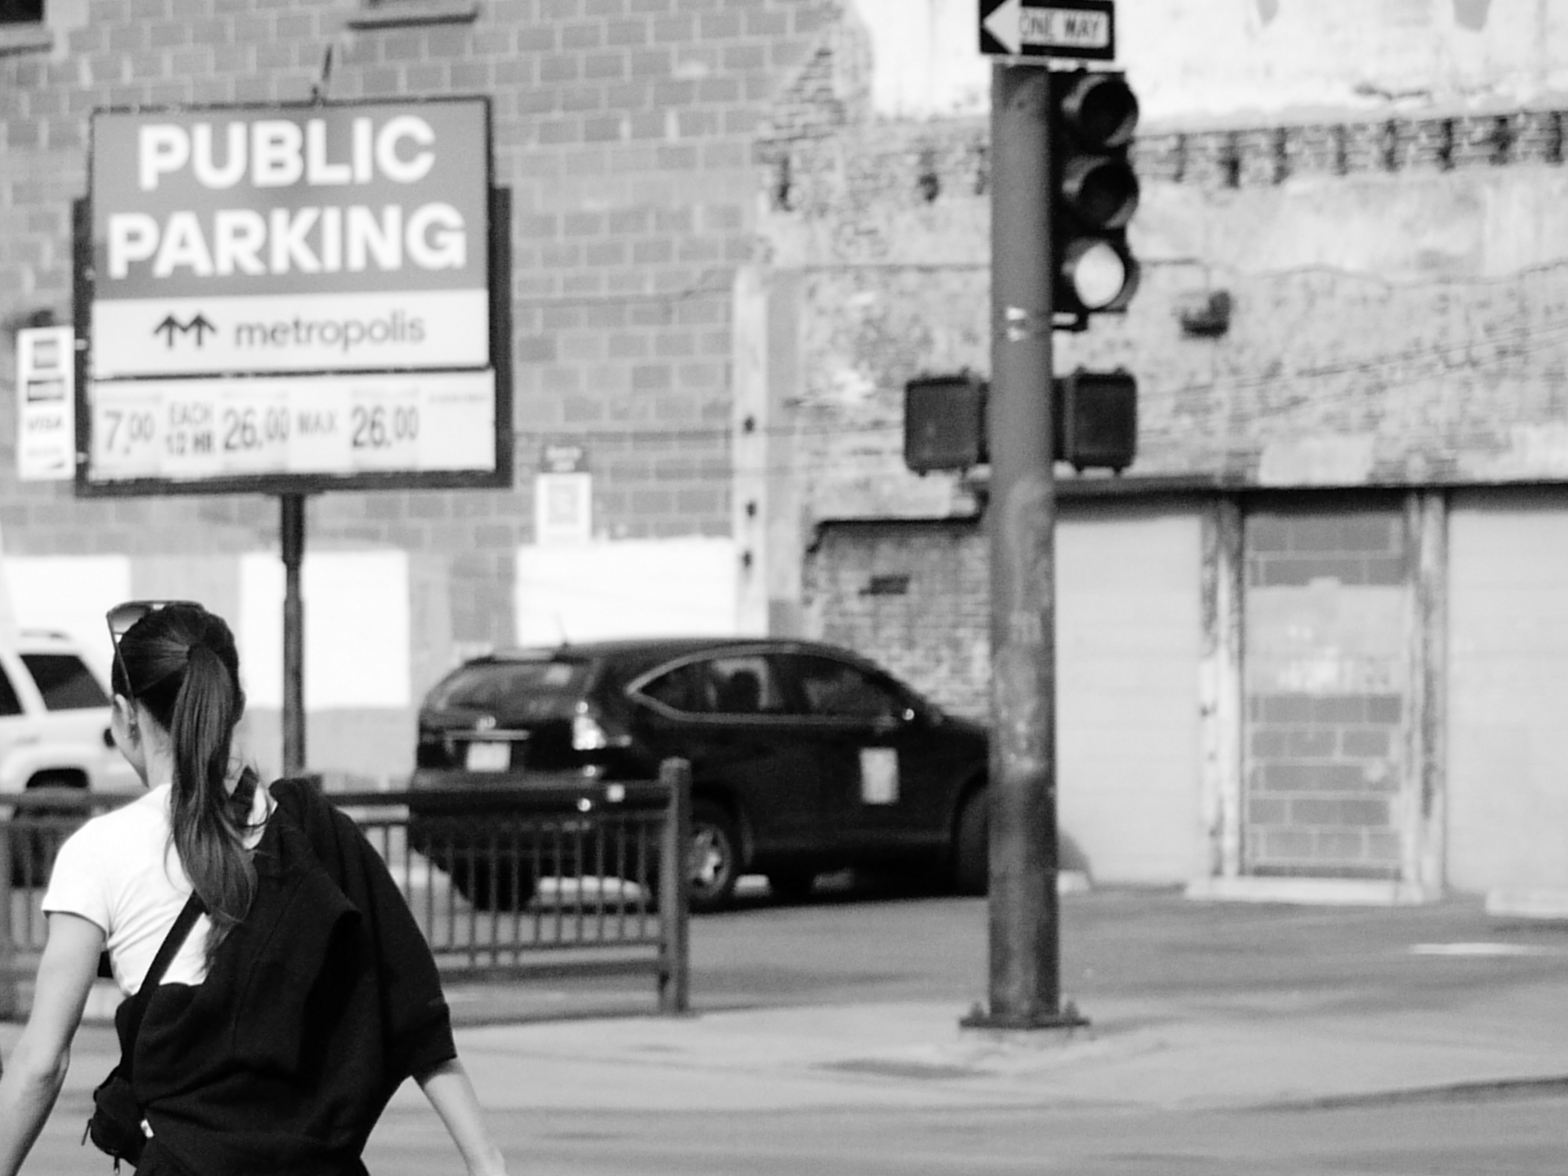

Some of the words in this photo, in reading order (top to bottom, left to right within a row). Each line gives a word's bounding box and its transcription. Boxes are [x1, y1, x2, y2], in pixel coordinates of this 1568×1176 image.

[1063, 12, 1101, 40] WAY
[139, 115, 436, 191] PUBLIC
[108, 202, 467, 280] PARKING
[234, 309, 426, 352] metropolis
[168, 401, 214, 428] EACH
[222, 405, 291, 452] 26.00
[351, 404, 420, 449] 26.00
